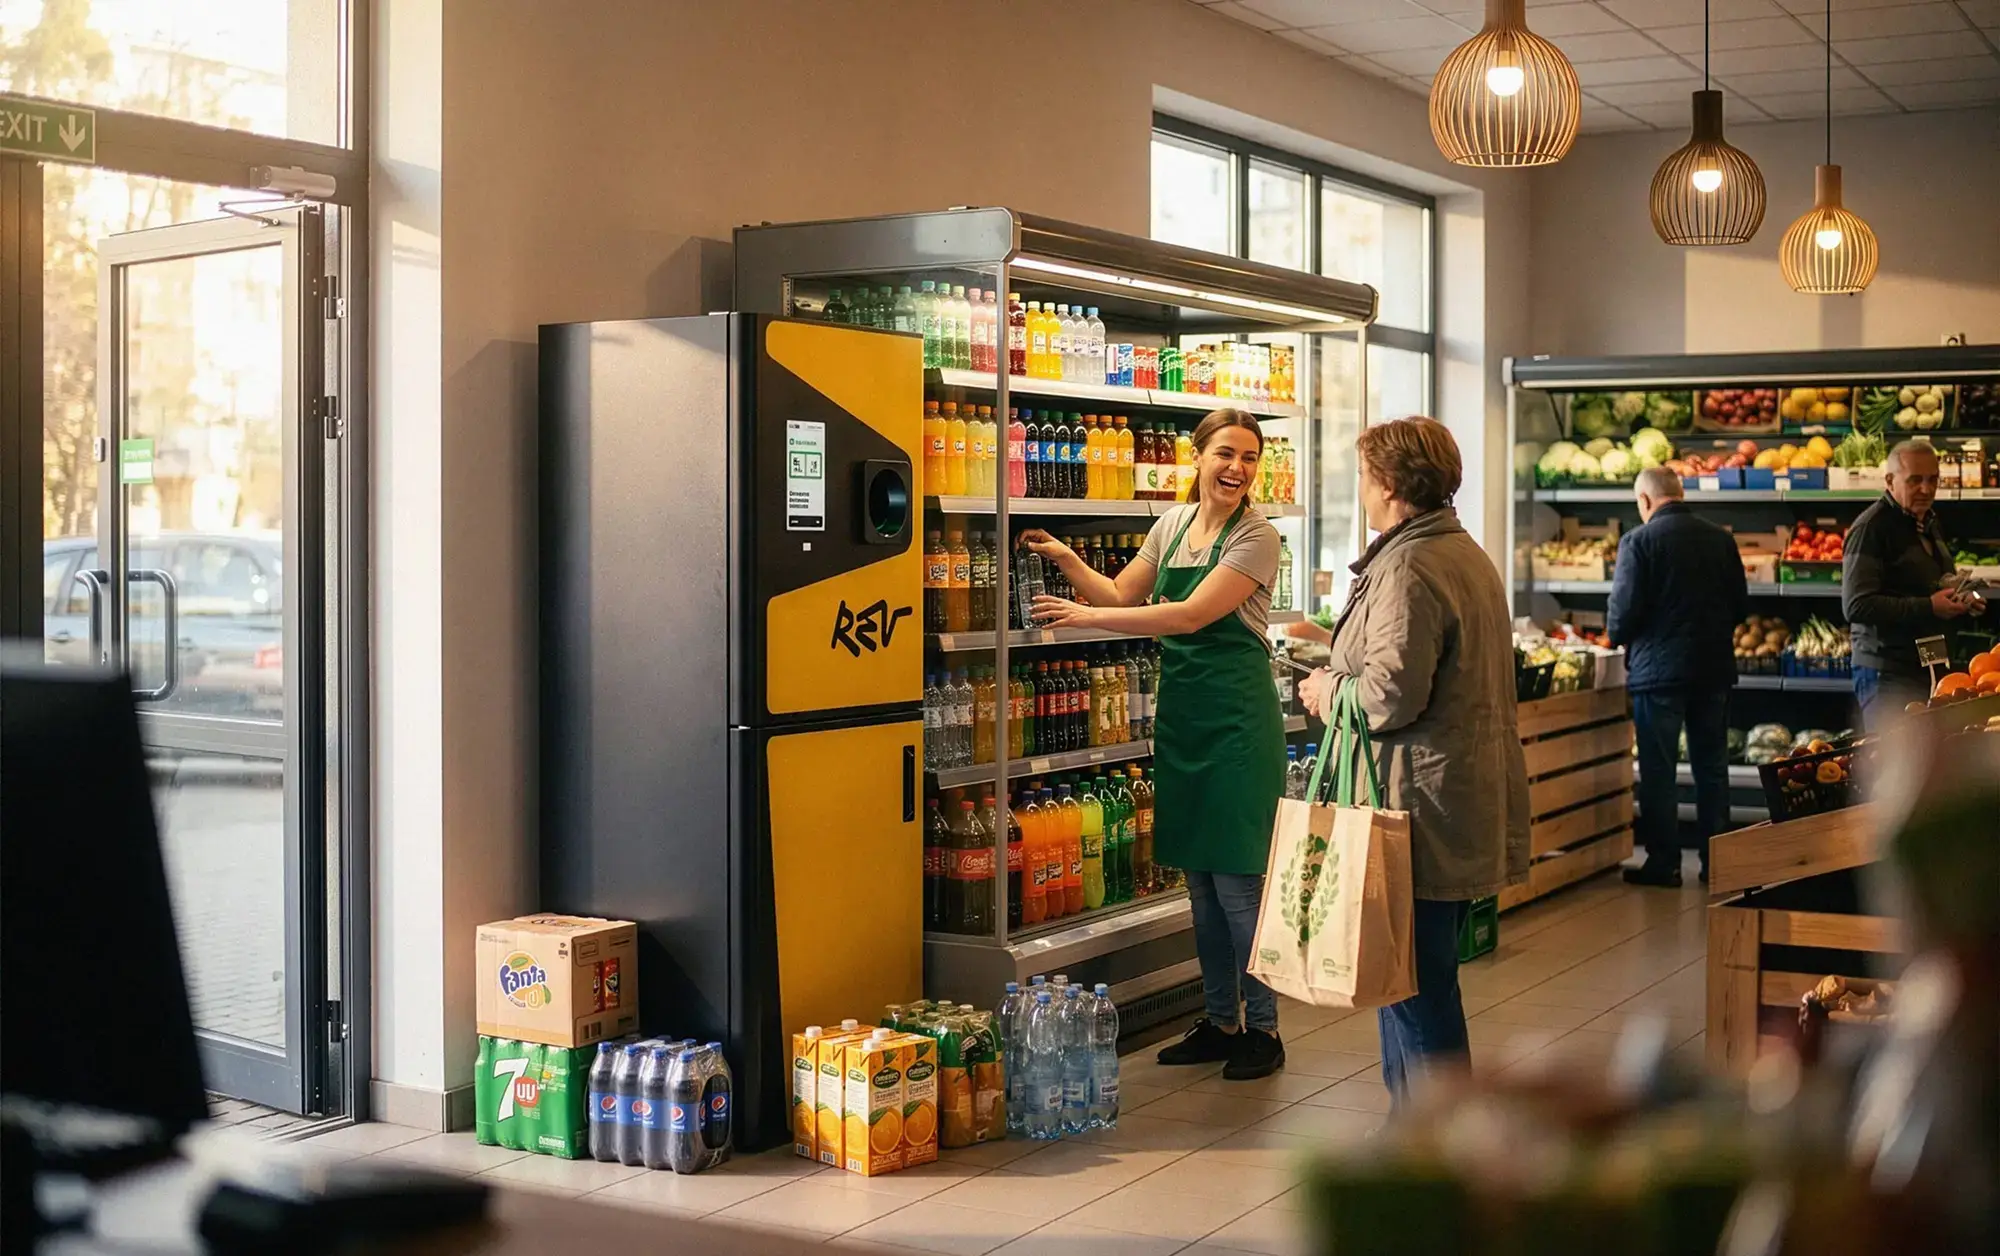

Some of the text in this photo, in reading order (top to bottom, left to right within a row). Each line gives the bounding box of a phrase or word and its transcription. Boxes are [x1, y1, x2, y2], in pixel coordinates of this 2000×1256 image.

[831, 599, 913, 658] REV
[499, 964, 547, 996] Fanta
[493, 1057, 530, 1123] 7
